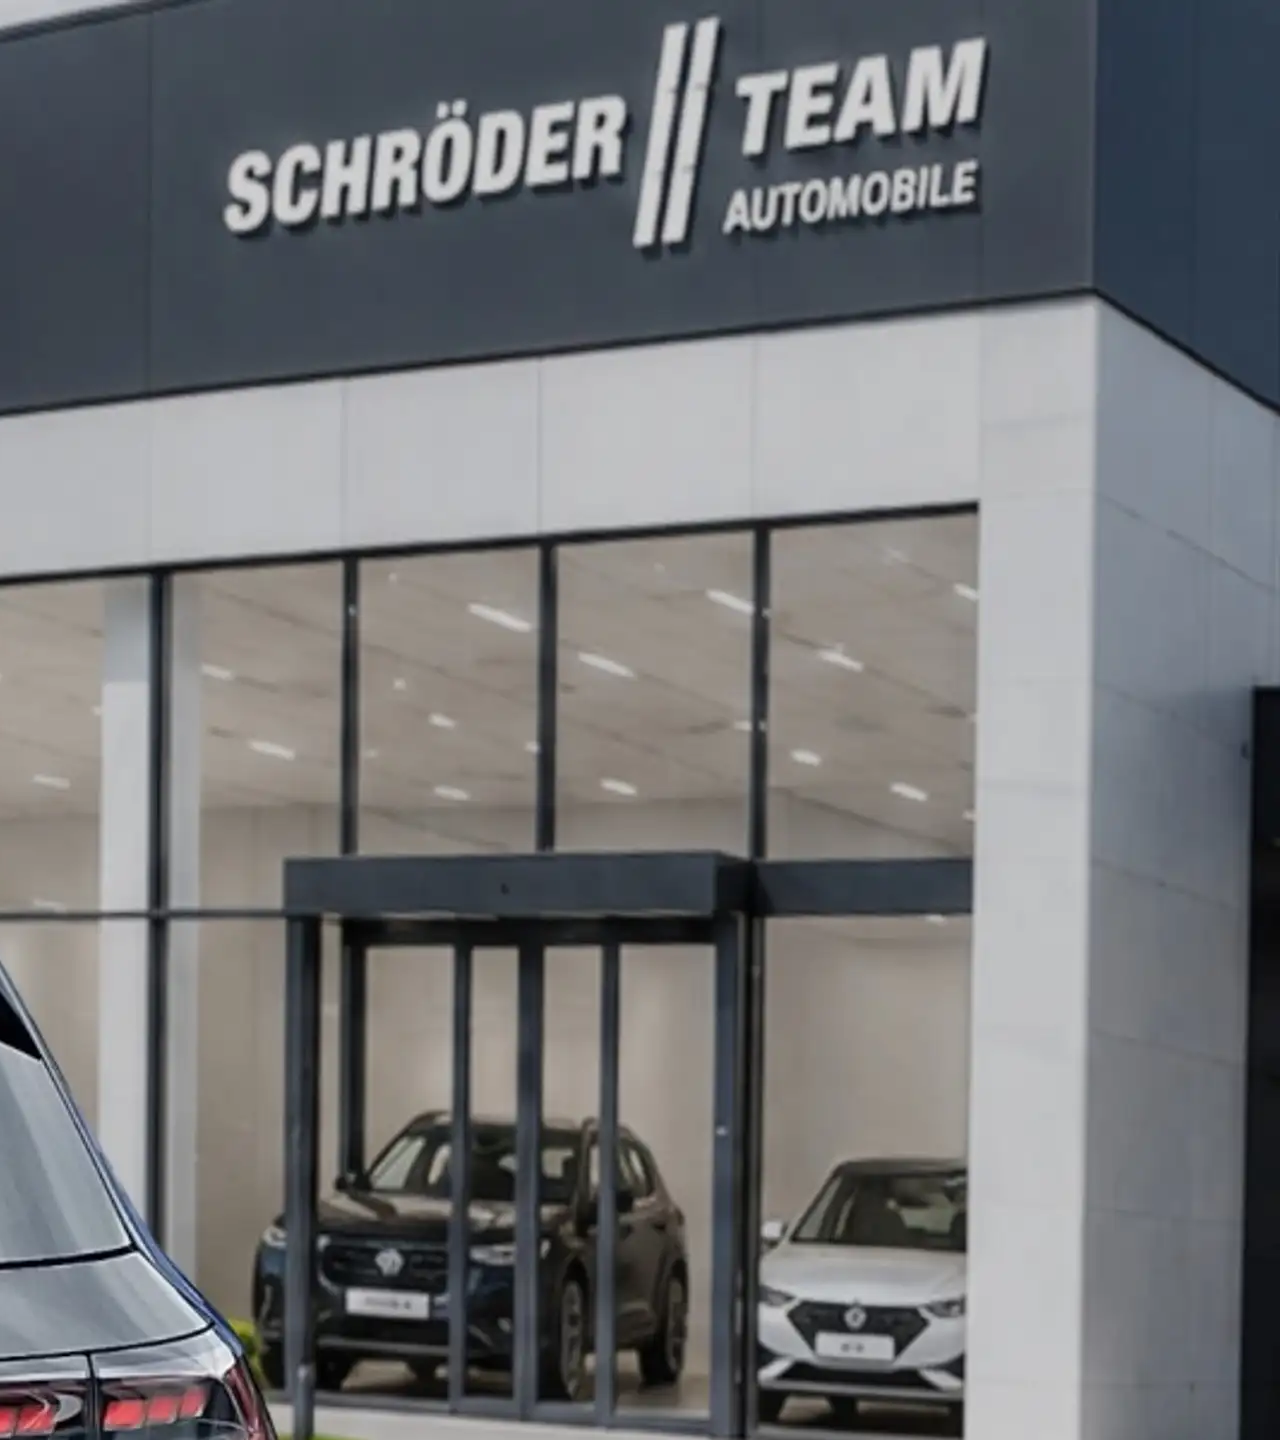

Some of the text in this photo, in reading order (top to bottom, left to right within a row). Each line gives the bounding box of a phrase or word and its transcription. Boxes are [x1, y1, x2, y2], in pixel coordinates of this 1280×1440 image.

[224, 38, 987, 234] SCHRÖDER TEAM
[724, 159, 979, 236] AUTOMOBILE
